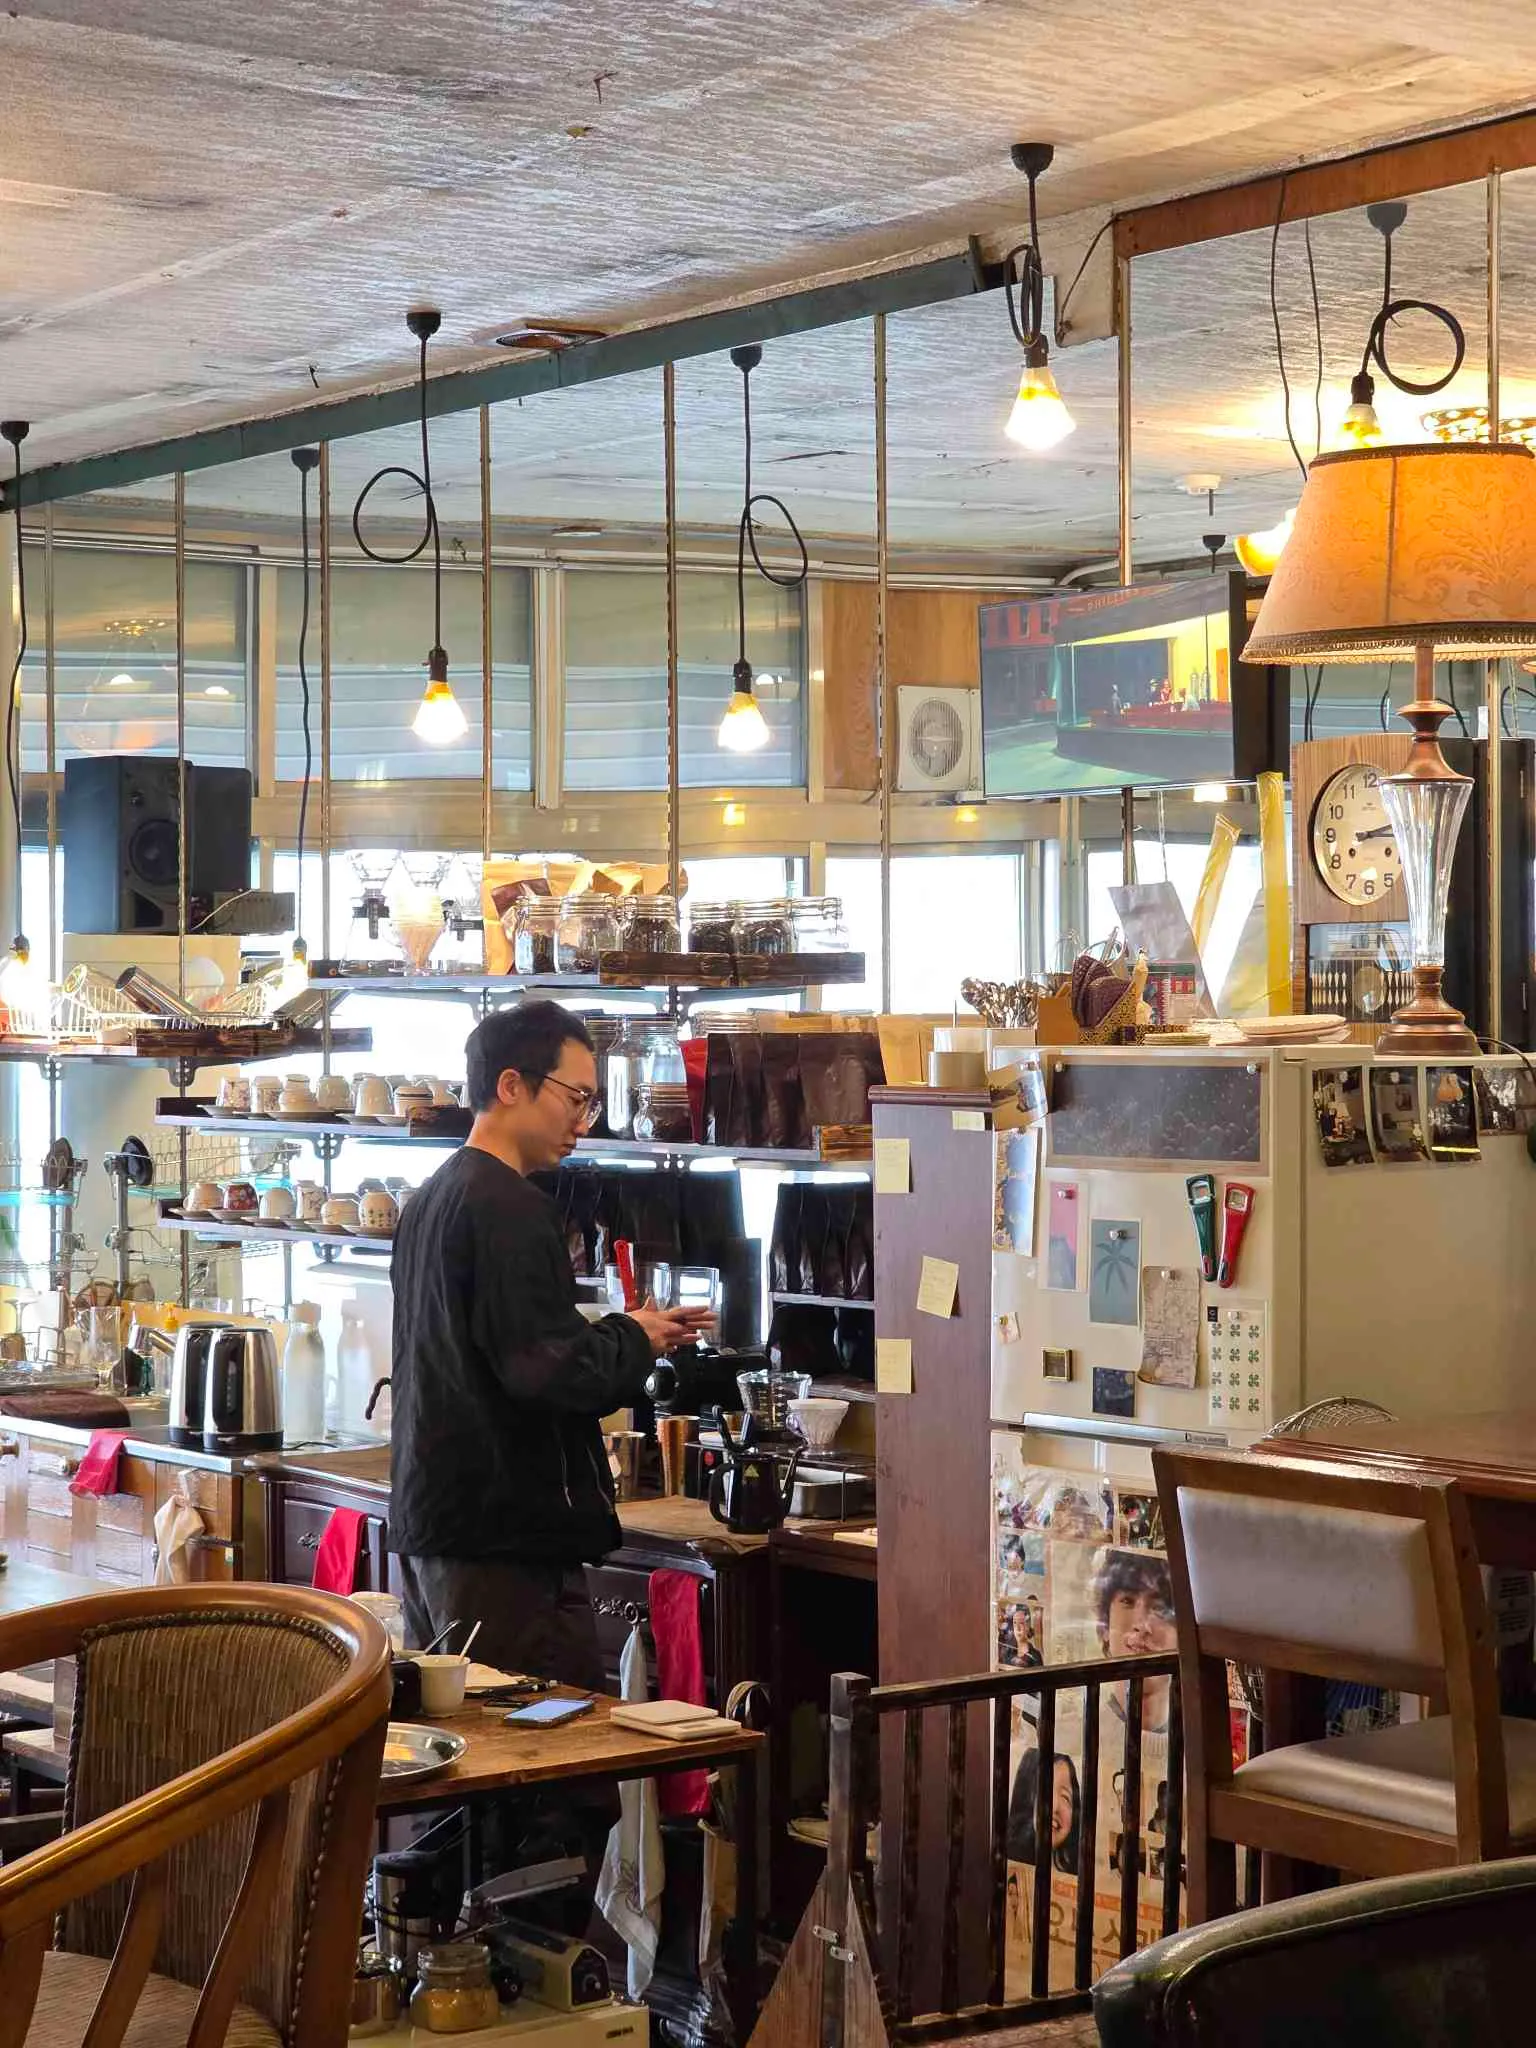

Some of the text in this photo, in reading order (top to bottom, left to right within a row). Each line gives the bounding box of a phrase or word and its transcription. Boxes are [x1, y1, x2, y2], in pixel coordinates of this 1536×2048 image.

[1363, 772, 1378, 788] 12
[1343, 784, 1355, 799] 11
[1328, 804, 1344, 820] 10
[1325, 828, 1336, 843] 9
[1331, 855, 1341, 869] 8
[1346, 874, 1357, 890] 7
[1364, 880, 1375, 895] 6
[1384, 873, 1394, 888] 5
